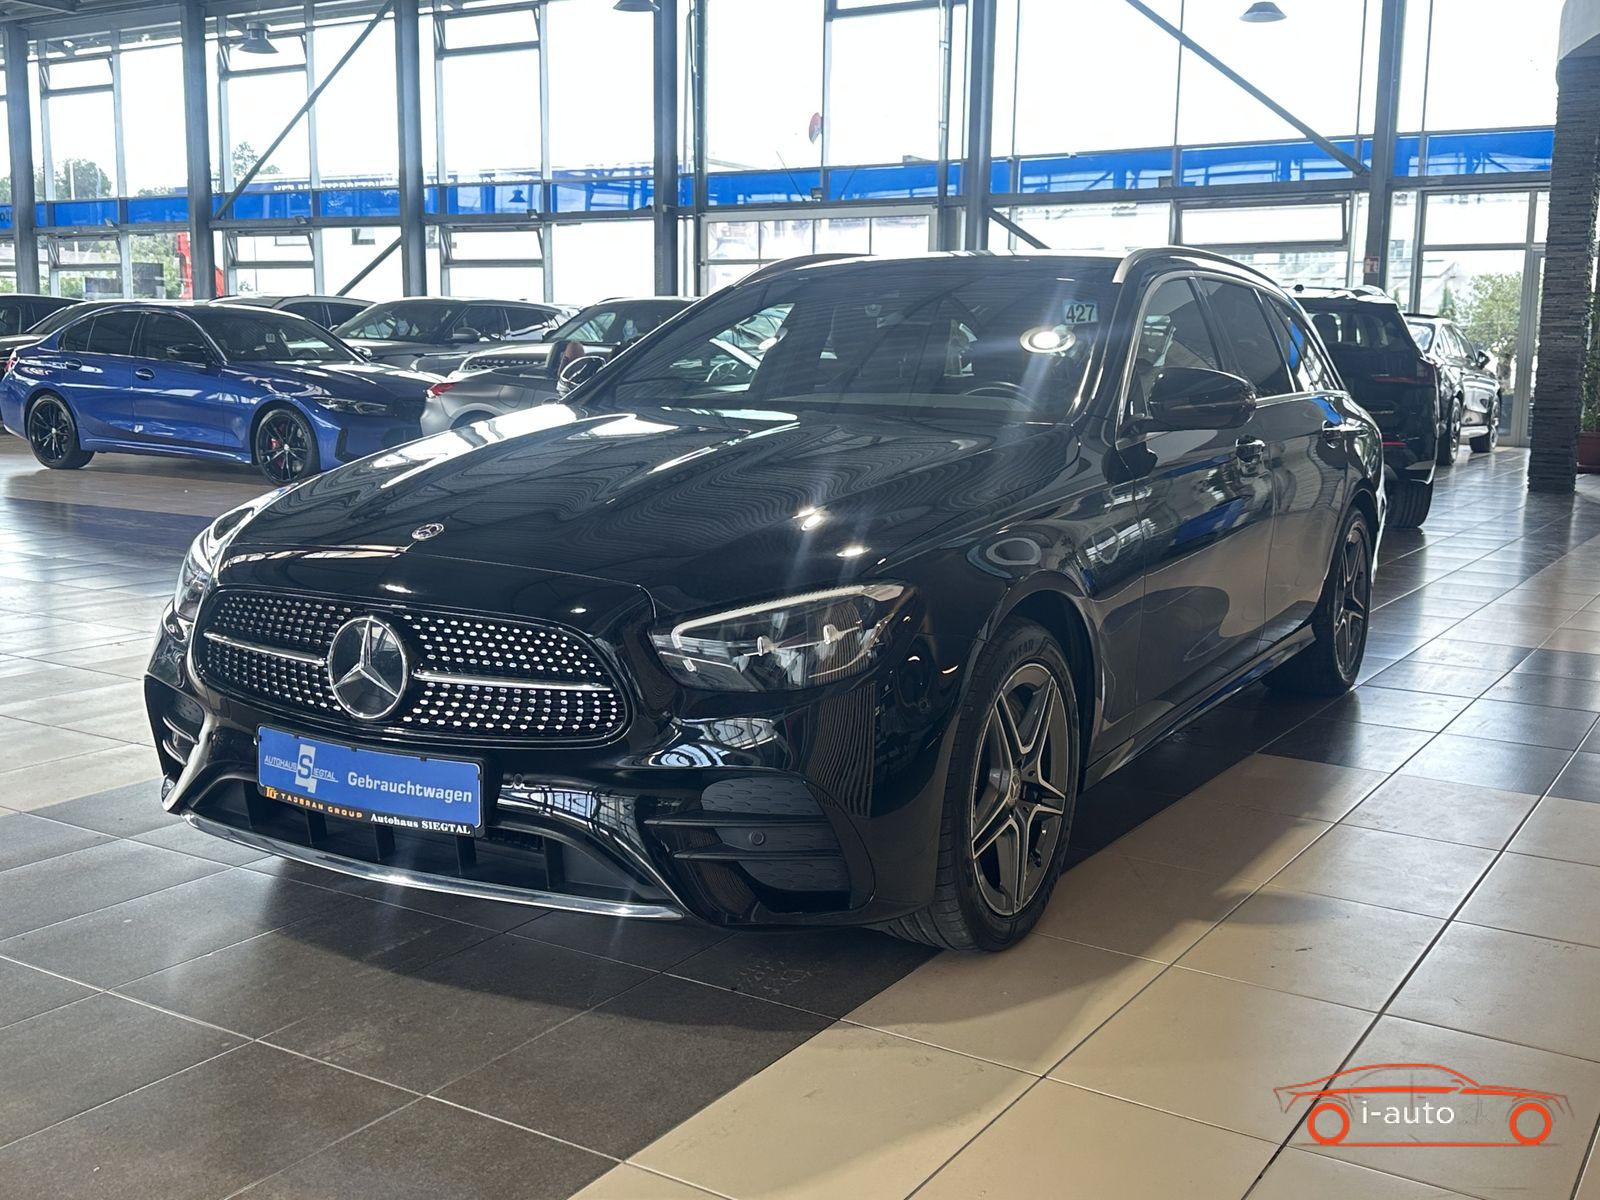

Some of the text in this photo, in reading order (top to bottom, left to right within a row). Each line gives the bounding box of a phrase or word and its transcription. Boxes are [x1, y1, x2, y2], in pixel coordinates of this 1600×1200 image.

[1066, 304, 1095, 323] 427
[264, 755, 297, 771] AUTOHAUS
[347, 771, 472, 804] Gebrauchtwagen
[327, 806, 363, 818] GROUP
[370, 813, 471, 835] Autohaus SIEGTAL
